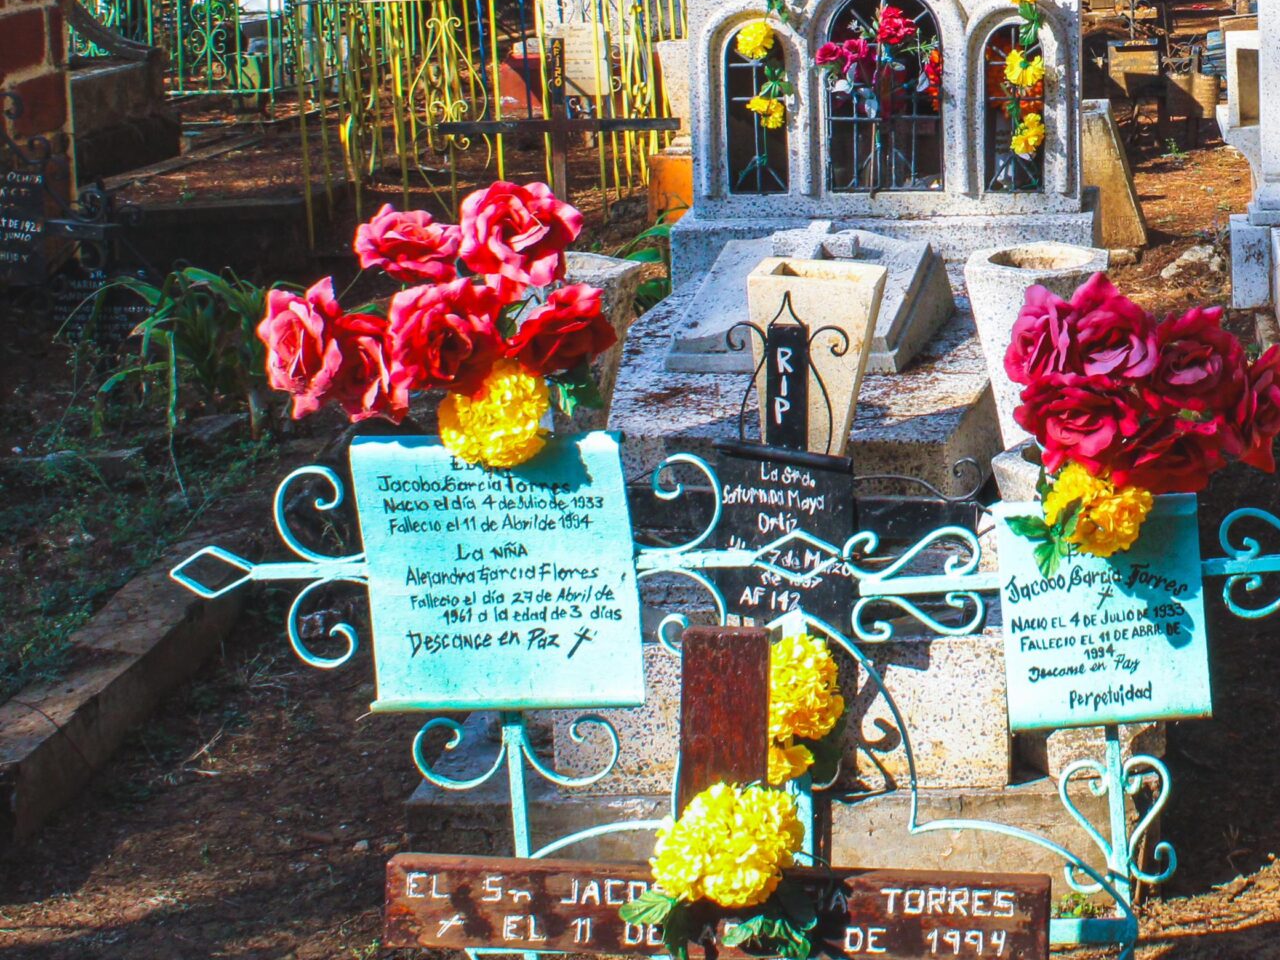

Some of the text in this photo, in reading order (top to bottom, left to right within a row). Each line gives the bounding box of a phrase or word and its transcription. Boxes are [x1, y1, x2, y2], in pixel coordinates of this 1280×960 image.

[775, 347, 794, 425] RIP
[377, 475, 441, 493] Jacobo
[506, 474, 571, 496] Torres
[435, 496, 448, 511] el
[482, 495, 496, 510] 4
[500, 496, 516, 510] de
[550, 495, 570, 512] de
[571, 496, 604, 510] 1933
[788, 489, 825, 515] Maya
[390, 513, 594, 534] Fallecio el 11 de Abril de 1994
[455, 543, 484, 561] La
[406, 565, 475, 588] Alejandra
[538, 560, 599, 583] Flores
[410, 592, 461, 610] Fallecio
[464, 591, 477, 606] el
[511, 591, 532, 606] 27
[535, 589, 553, 603] de
[556, 584, 592, 604] Abril
[594, 584, 618, 602] de
[740, 586, 765, 605] AF
[478, 611, 489, 623] a
[493, 606, 510, 623] la
[513, 606, 548, 624] edad
[551, 606, 568, 620] de
[569, 604, 583, 619] 3
[1051, 617, 1067, 629] EL
[1070, 612, 1080, 627] 4
[1083, 615, 1098, 627] DE
[1136, 610, 1149, 622] DE
[1153, 602, 1185, 618] 1933
[496, 630, 522, 646] en
[527, 628, 562, 651] Paz
[1080, 635, 1094, 646] EL
[1098, 630, 1110, 643] 11
[1114, 628, 1129, 640] DE
[1166, 622, 1181, 637] DE
[1089, 661, 1107, 674] en
[405, 870, 449, 899] EL
[560, 878, 666, 907] JACO
[881, 887, 1015, 918] TORRES
[502, 916, 547, 942] EL
[571, 917, 592, 944] 11
[844, 927, 887, 953] DE
[926, 929, 1007, 957] 1994
